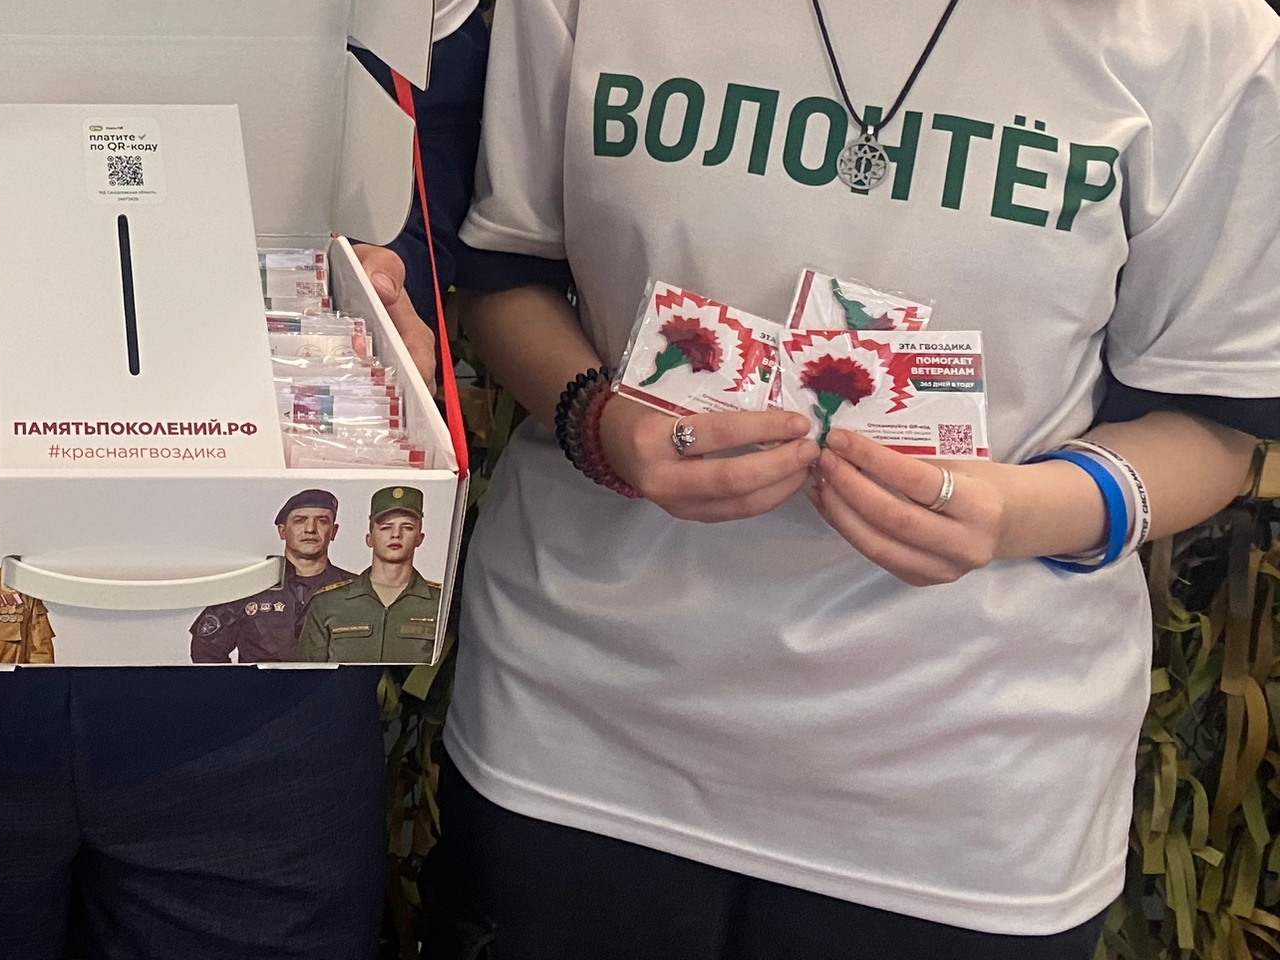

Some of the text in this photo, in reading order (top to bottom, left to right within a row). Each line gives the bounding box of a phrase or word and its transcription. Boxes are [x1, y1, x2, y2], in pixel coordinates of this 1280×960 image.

[107, 142, 158, 152] QR-коду
[593, 72, 1120, 232] ВОЛОНТЁР
[919, 343, 972, 351] ГВОЗДИКА
[916, 357, 973, 365] ПОМОГАЕТ
[910, 367, 975, 375] ВЕТЕРАНАМ
[13, 419, 258, 436] ПАМЯТЬПОКОЛЕНИЙ.РФ
[48, 444, 227, 461] #краснаягвоздика
